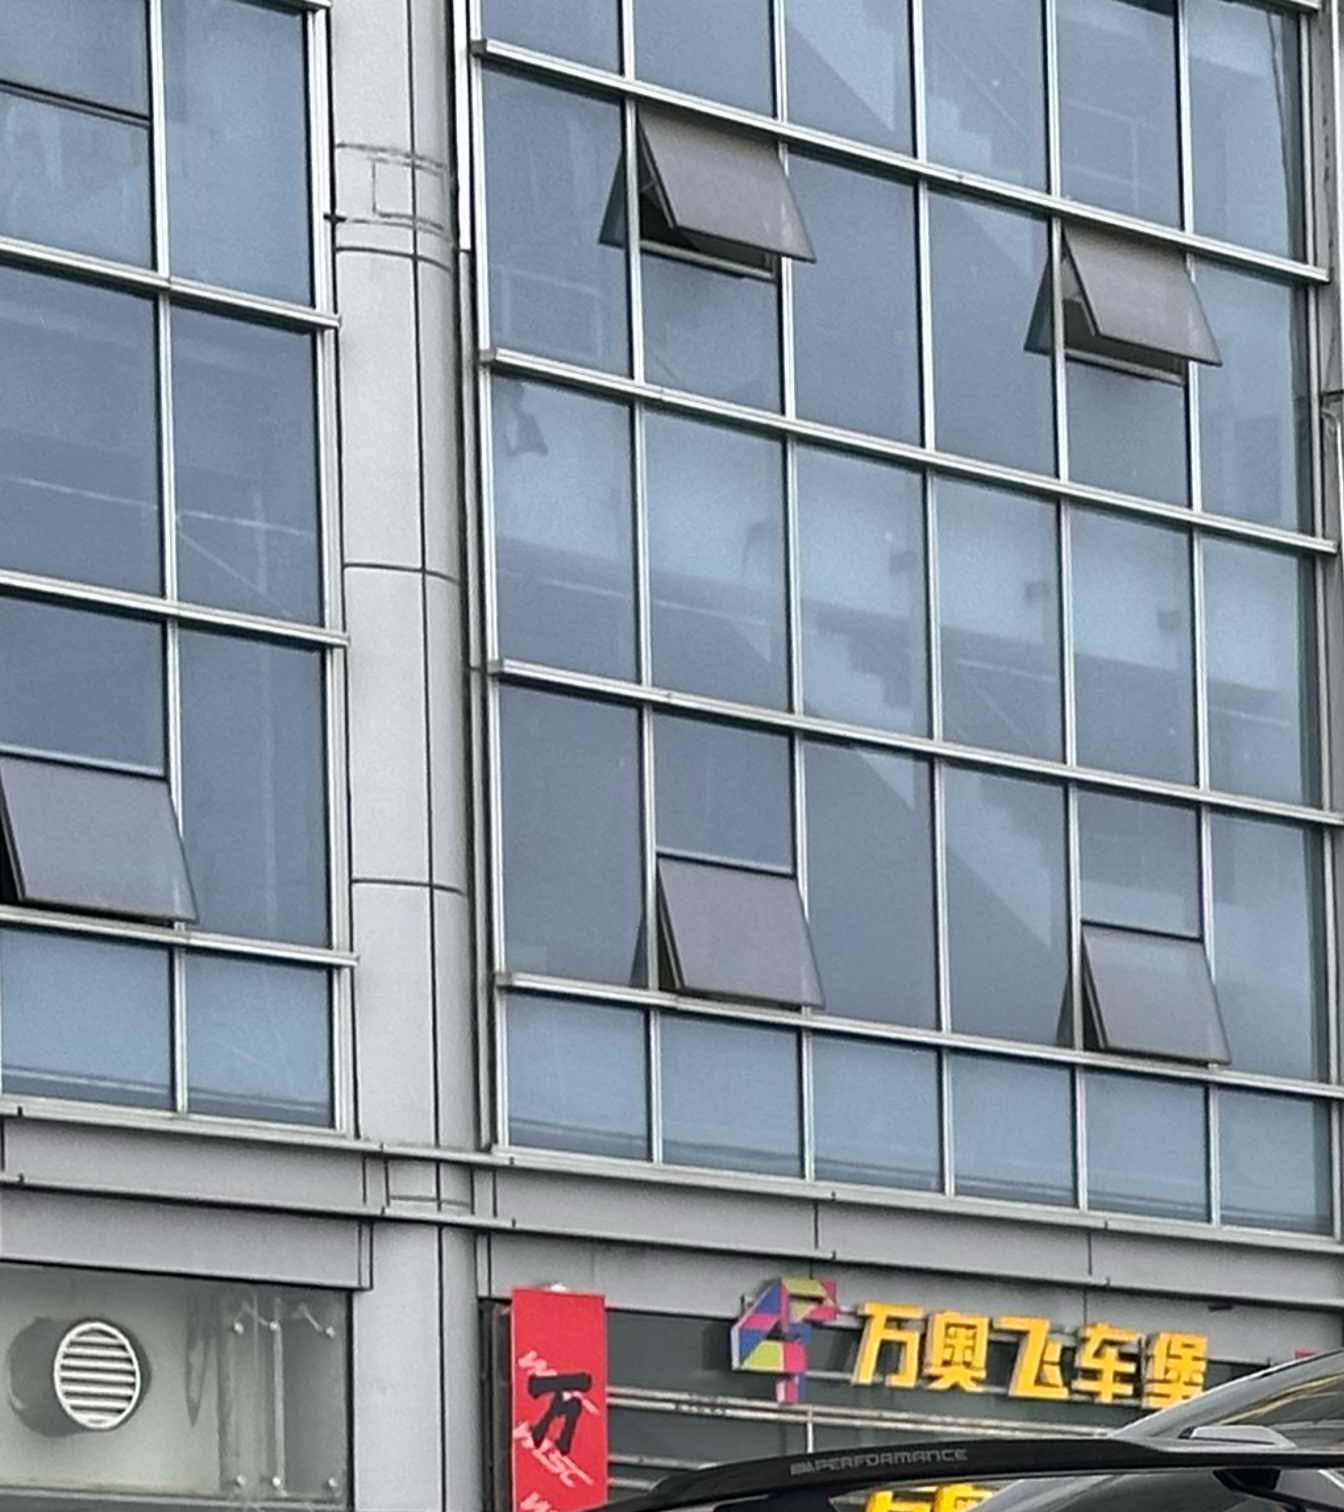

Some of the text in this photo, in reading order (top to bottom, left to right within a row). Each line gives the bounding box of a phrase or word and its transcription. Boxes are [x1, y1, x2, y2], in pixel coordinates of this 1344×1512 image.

[850, 1301, 1209, 1409] 万奥飞车堡
